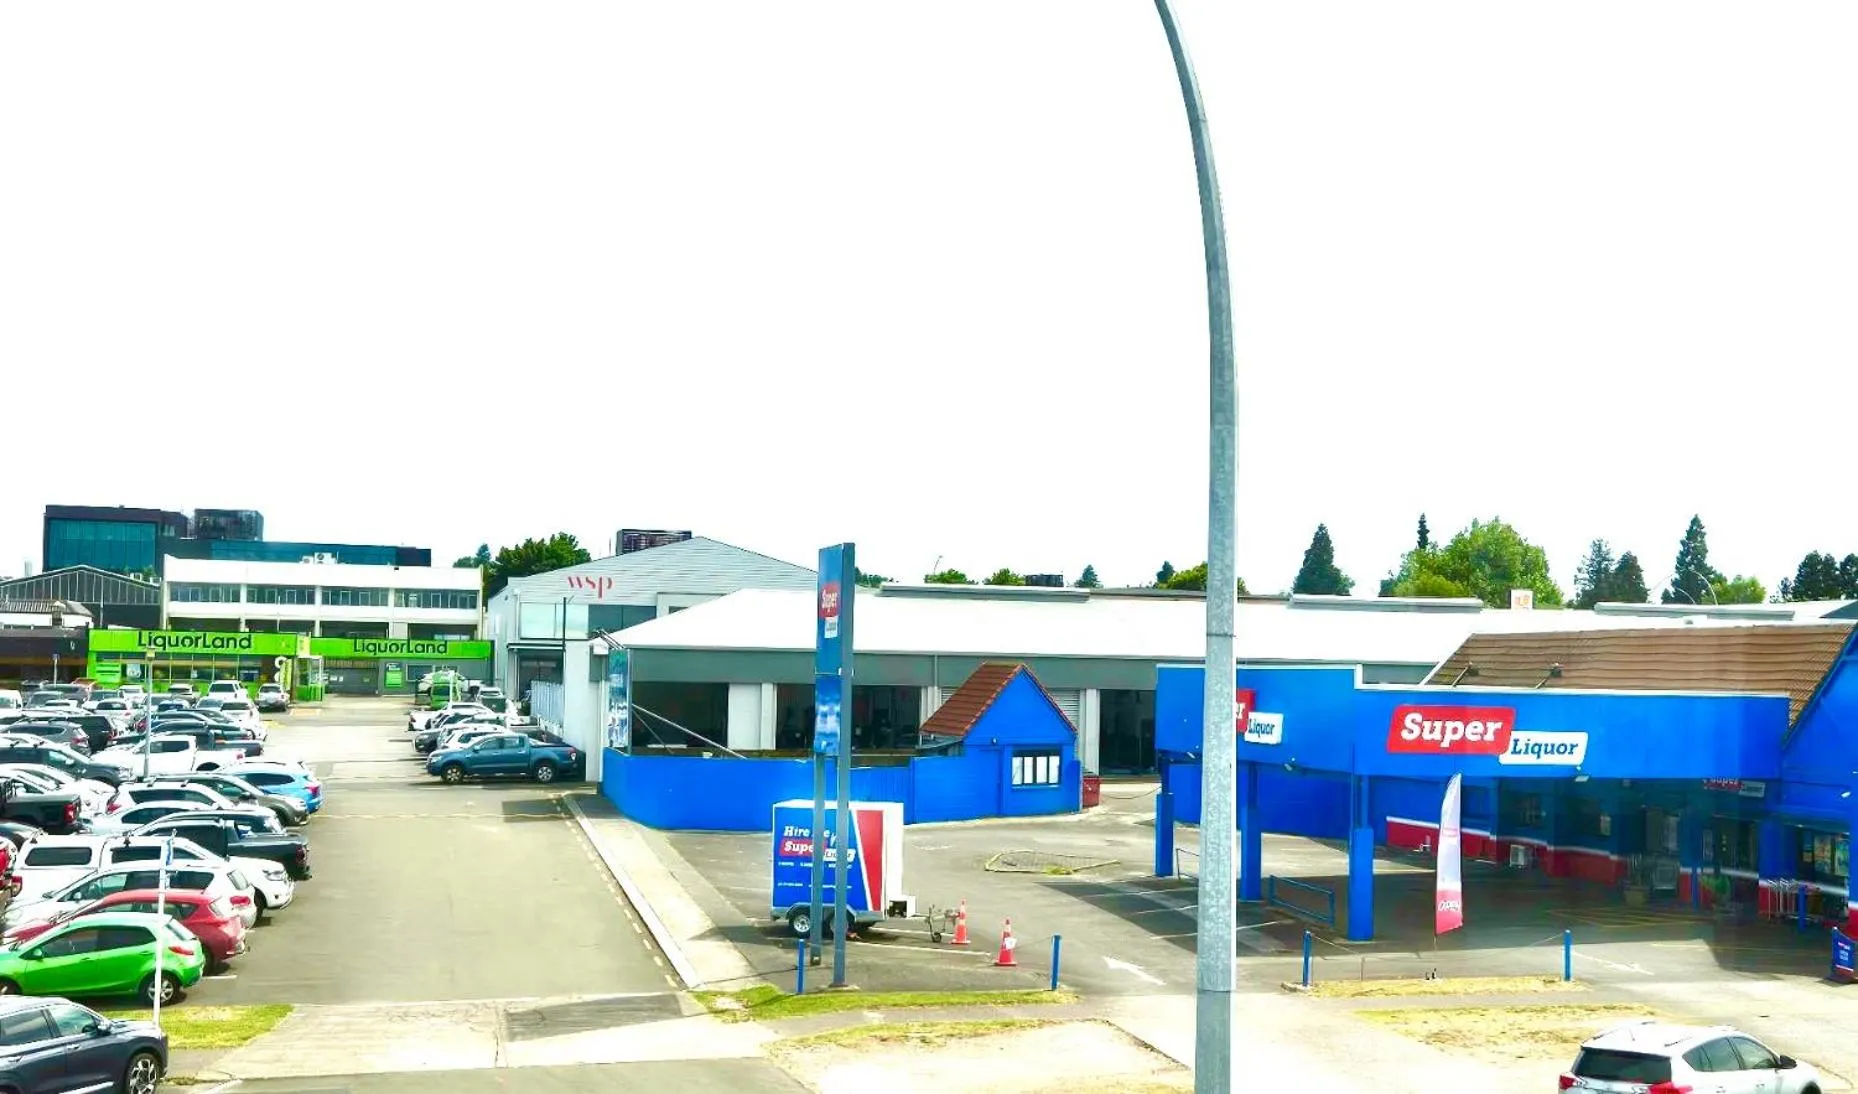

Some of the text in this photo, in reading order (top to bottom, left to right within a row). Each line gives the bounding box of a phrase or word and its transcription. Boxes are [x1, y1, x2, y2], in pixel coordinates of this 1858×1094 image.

[568, 576, 613, 598] wsp
[1248, 718, 1276, 737] Liquor
[1401, 712, 1503, 748] Super
[1511, 738, 1579, 759] Liquor
[784, 825, 810, 837] Hire
[784, 841, 815, 855] Supe
